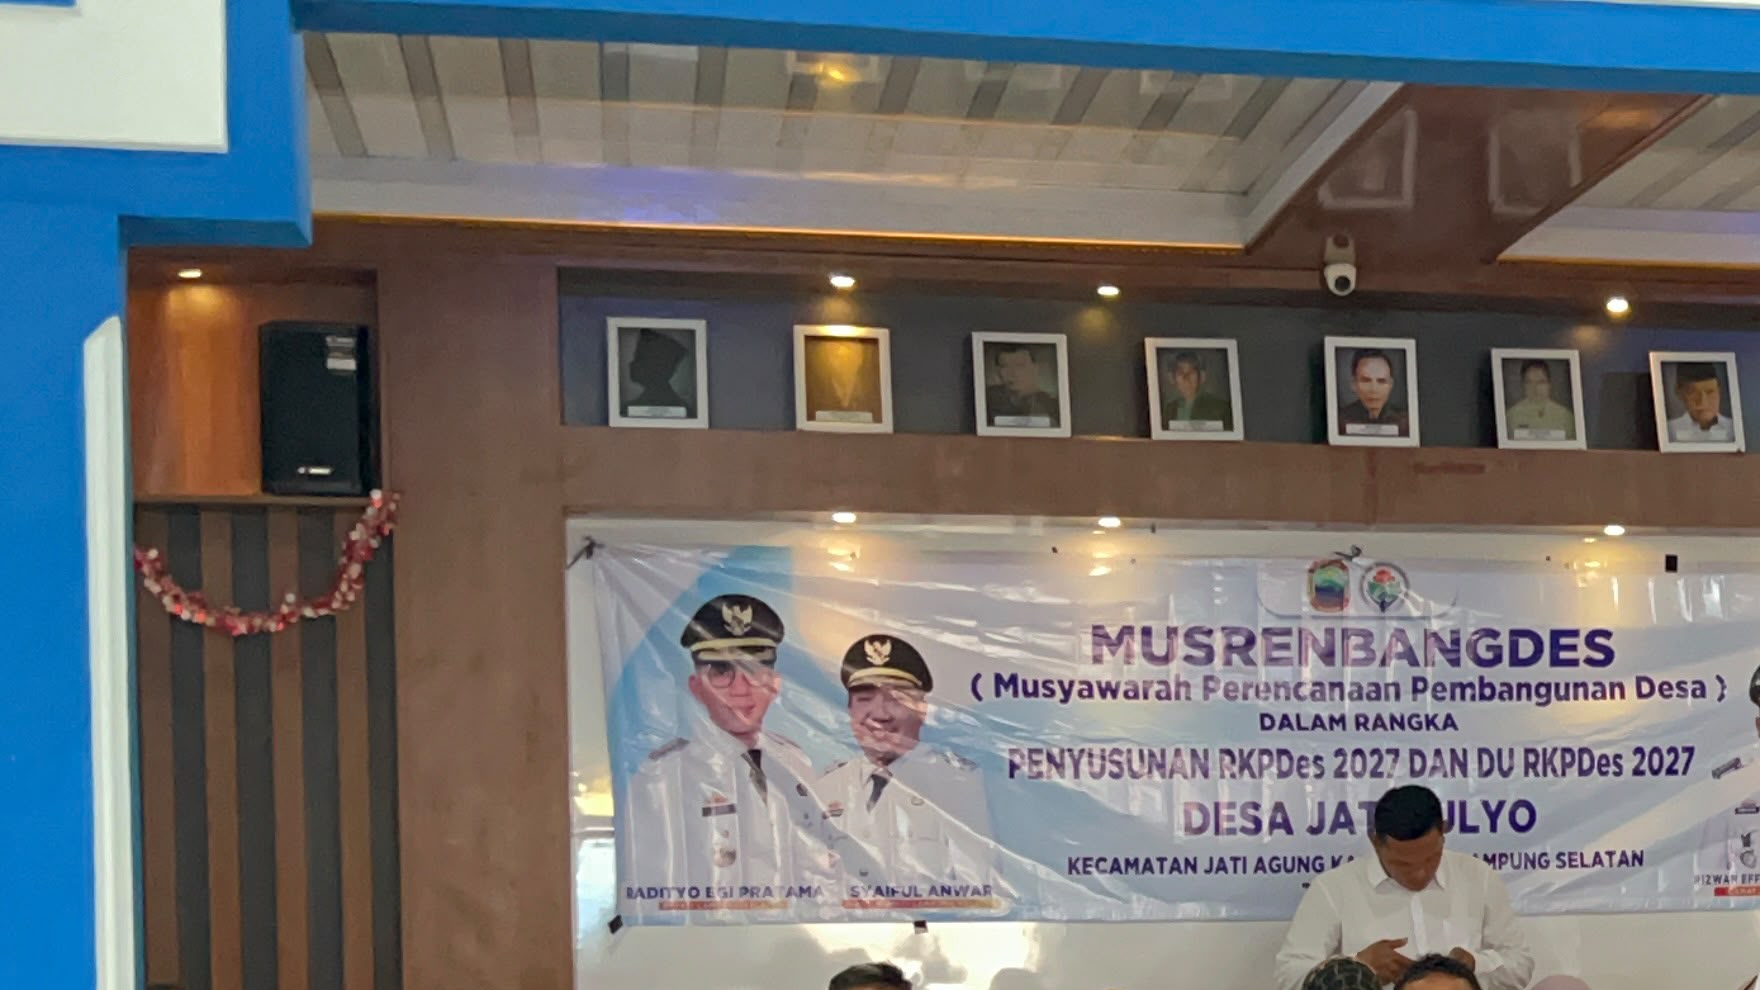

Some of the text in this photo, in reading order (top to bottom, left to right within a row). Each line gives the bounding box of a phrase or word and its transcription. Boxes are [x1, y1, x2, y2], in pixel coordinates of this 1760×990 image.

[1091, 625, 1615, 669] MUSRENBANGDES
[994, 672, 1191, 705] Musyawarah
[1203, 674, 1399, 702] Perencanaan
[1411, 675, 1626, 707] Pembangunan
[1636, 674, 1707, 700] Desa
[1260, 712, 1459, 732] DALAM RANGKA
[1008, 745, 1696, 780] PENYUSUNAN RKPDes 2027 DAN DU RKPDes 2027
[1183, 800, 1295, 836] DESA
[1067, 855, 1198, 876] KECAMATAN
[1204, 855, 1248, 876] JATI
[1254, 854, 1325, 875] AGUNG
[1555, 849, 1645, 871] SELATAN
[739, 885, 824, 899] PRAAMA
[928, 884, 993, 898] ANWAR
